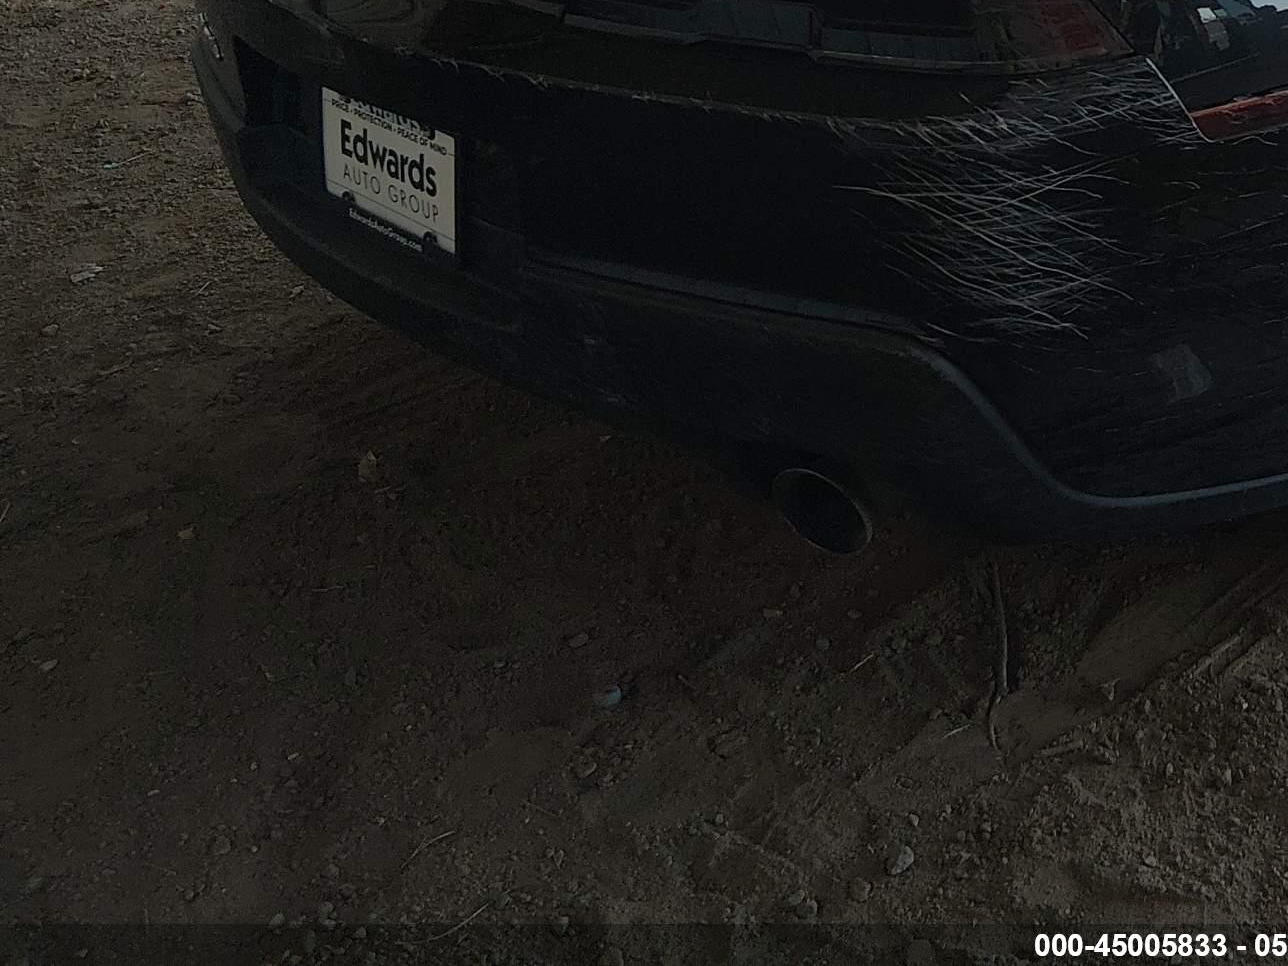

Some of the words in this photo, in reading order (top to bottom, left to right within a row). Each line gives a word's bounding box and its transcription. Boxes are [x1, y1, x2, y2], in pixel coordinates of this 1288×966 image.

[340, 119, 438, 197] Edwards
[343, 163, 381, 195] AUTO
[388, 184, 439, 223] GROUP
